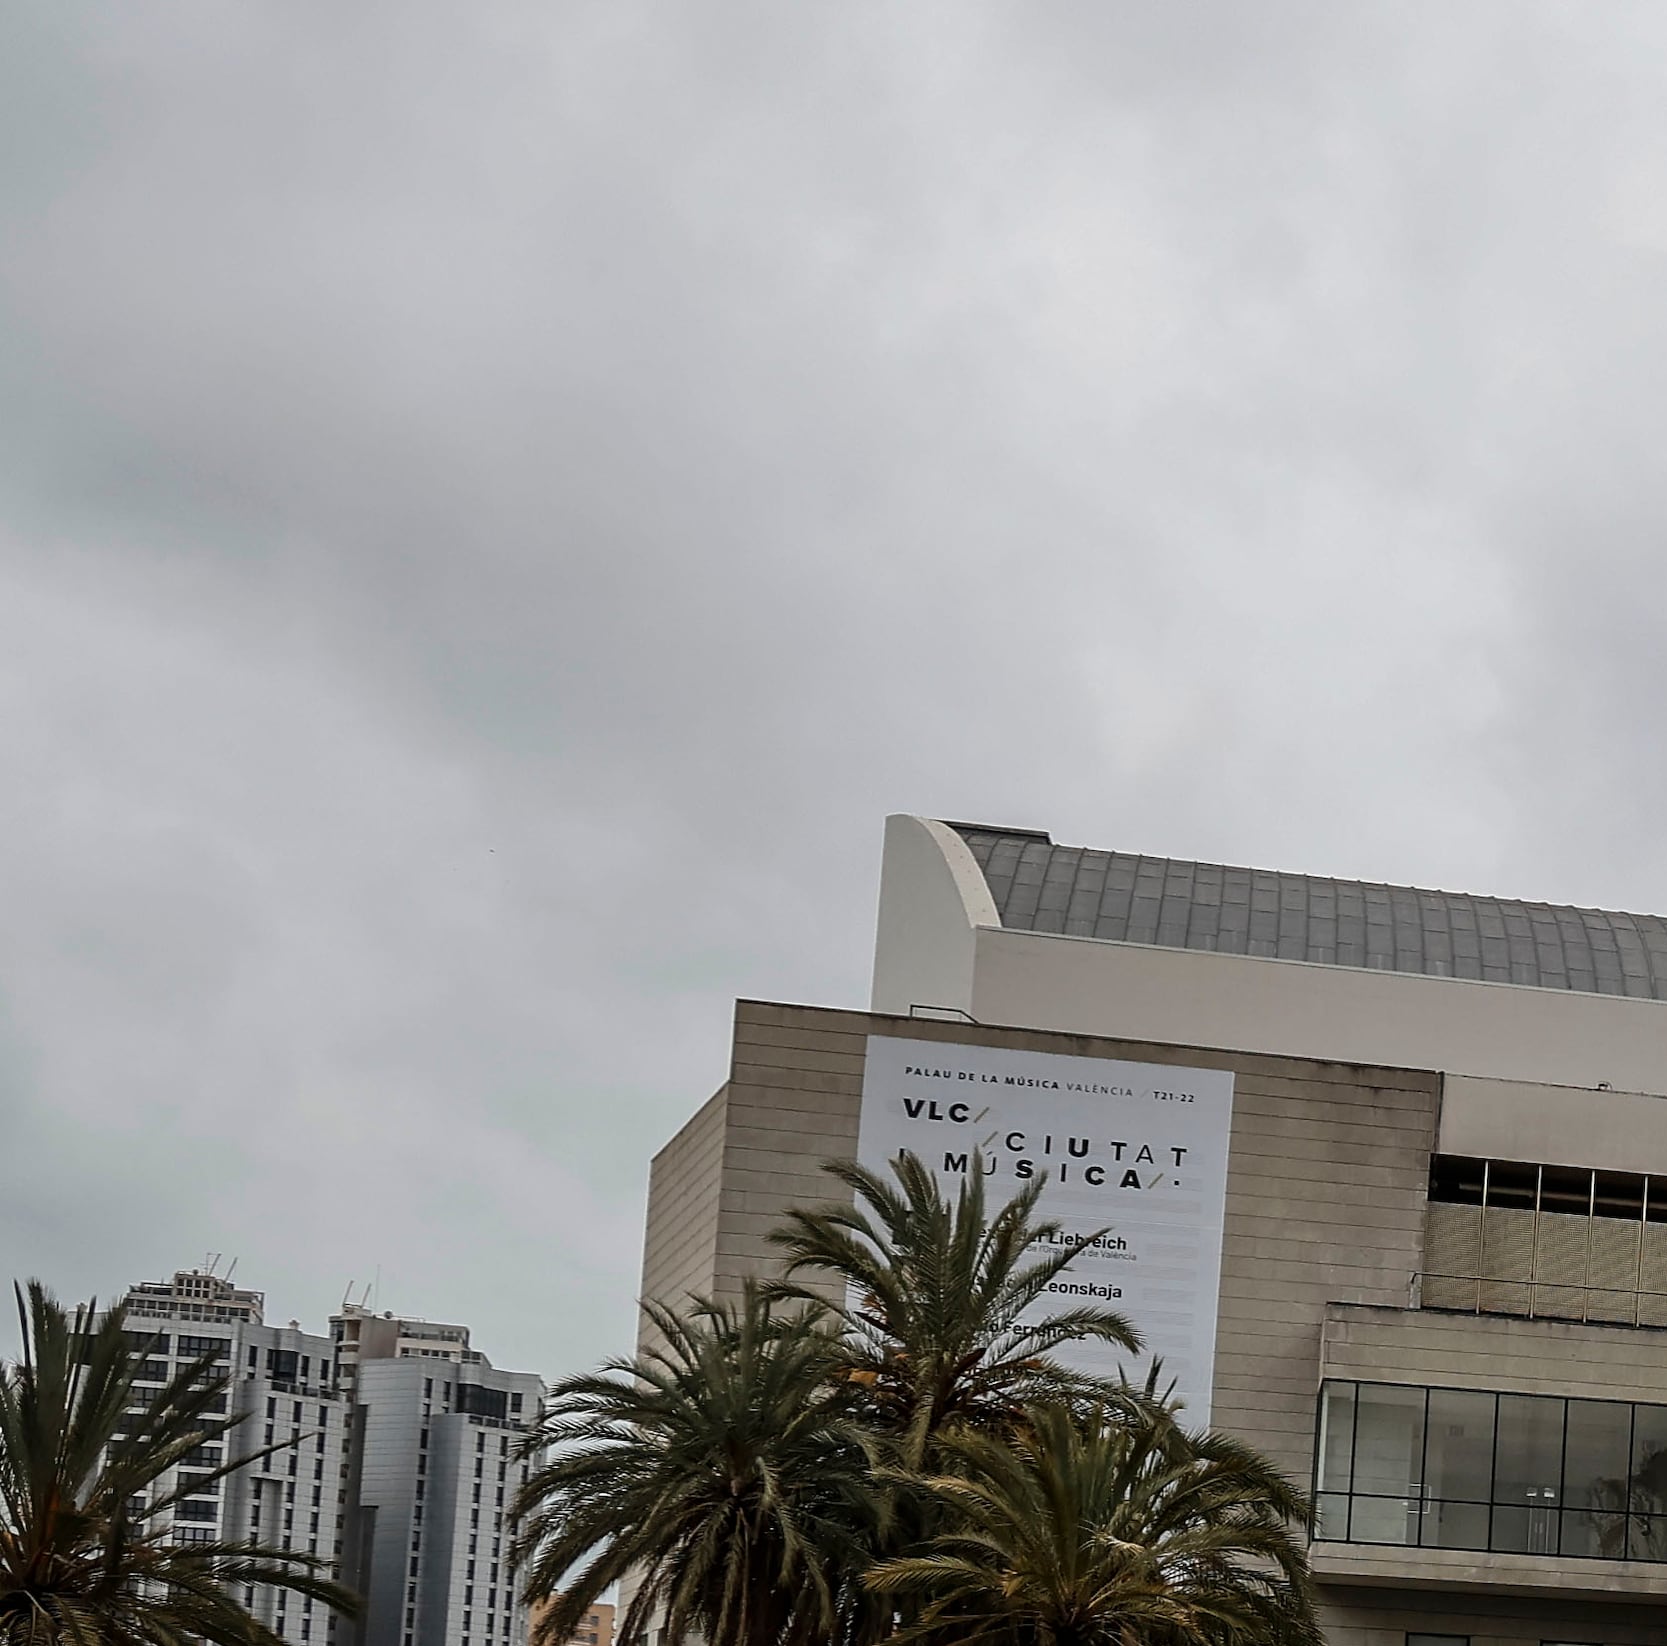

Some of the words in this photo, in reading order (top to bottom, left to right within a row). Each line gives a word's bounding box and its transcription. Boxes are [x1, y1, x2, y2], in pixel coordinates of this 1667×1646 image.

[904, 1066, 951, 1079] PALAU
[958, 1071, 975, 1081] DE
[982, 1074, 998, 1084] LA
[1005, 1075, 1059, 1090] MÚSICA
[1153, 1090, 1195, 1103] T21-22
[1050, 1231, 1127, 1250] Liebeich
